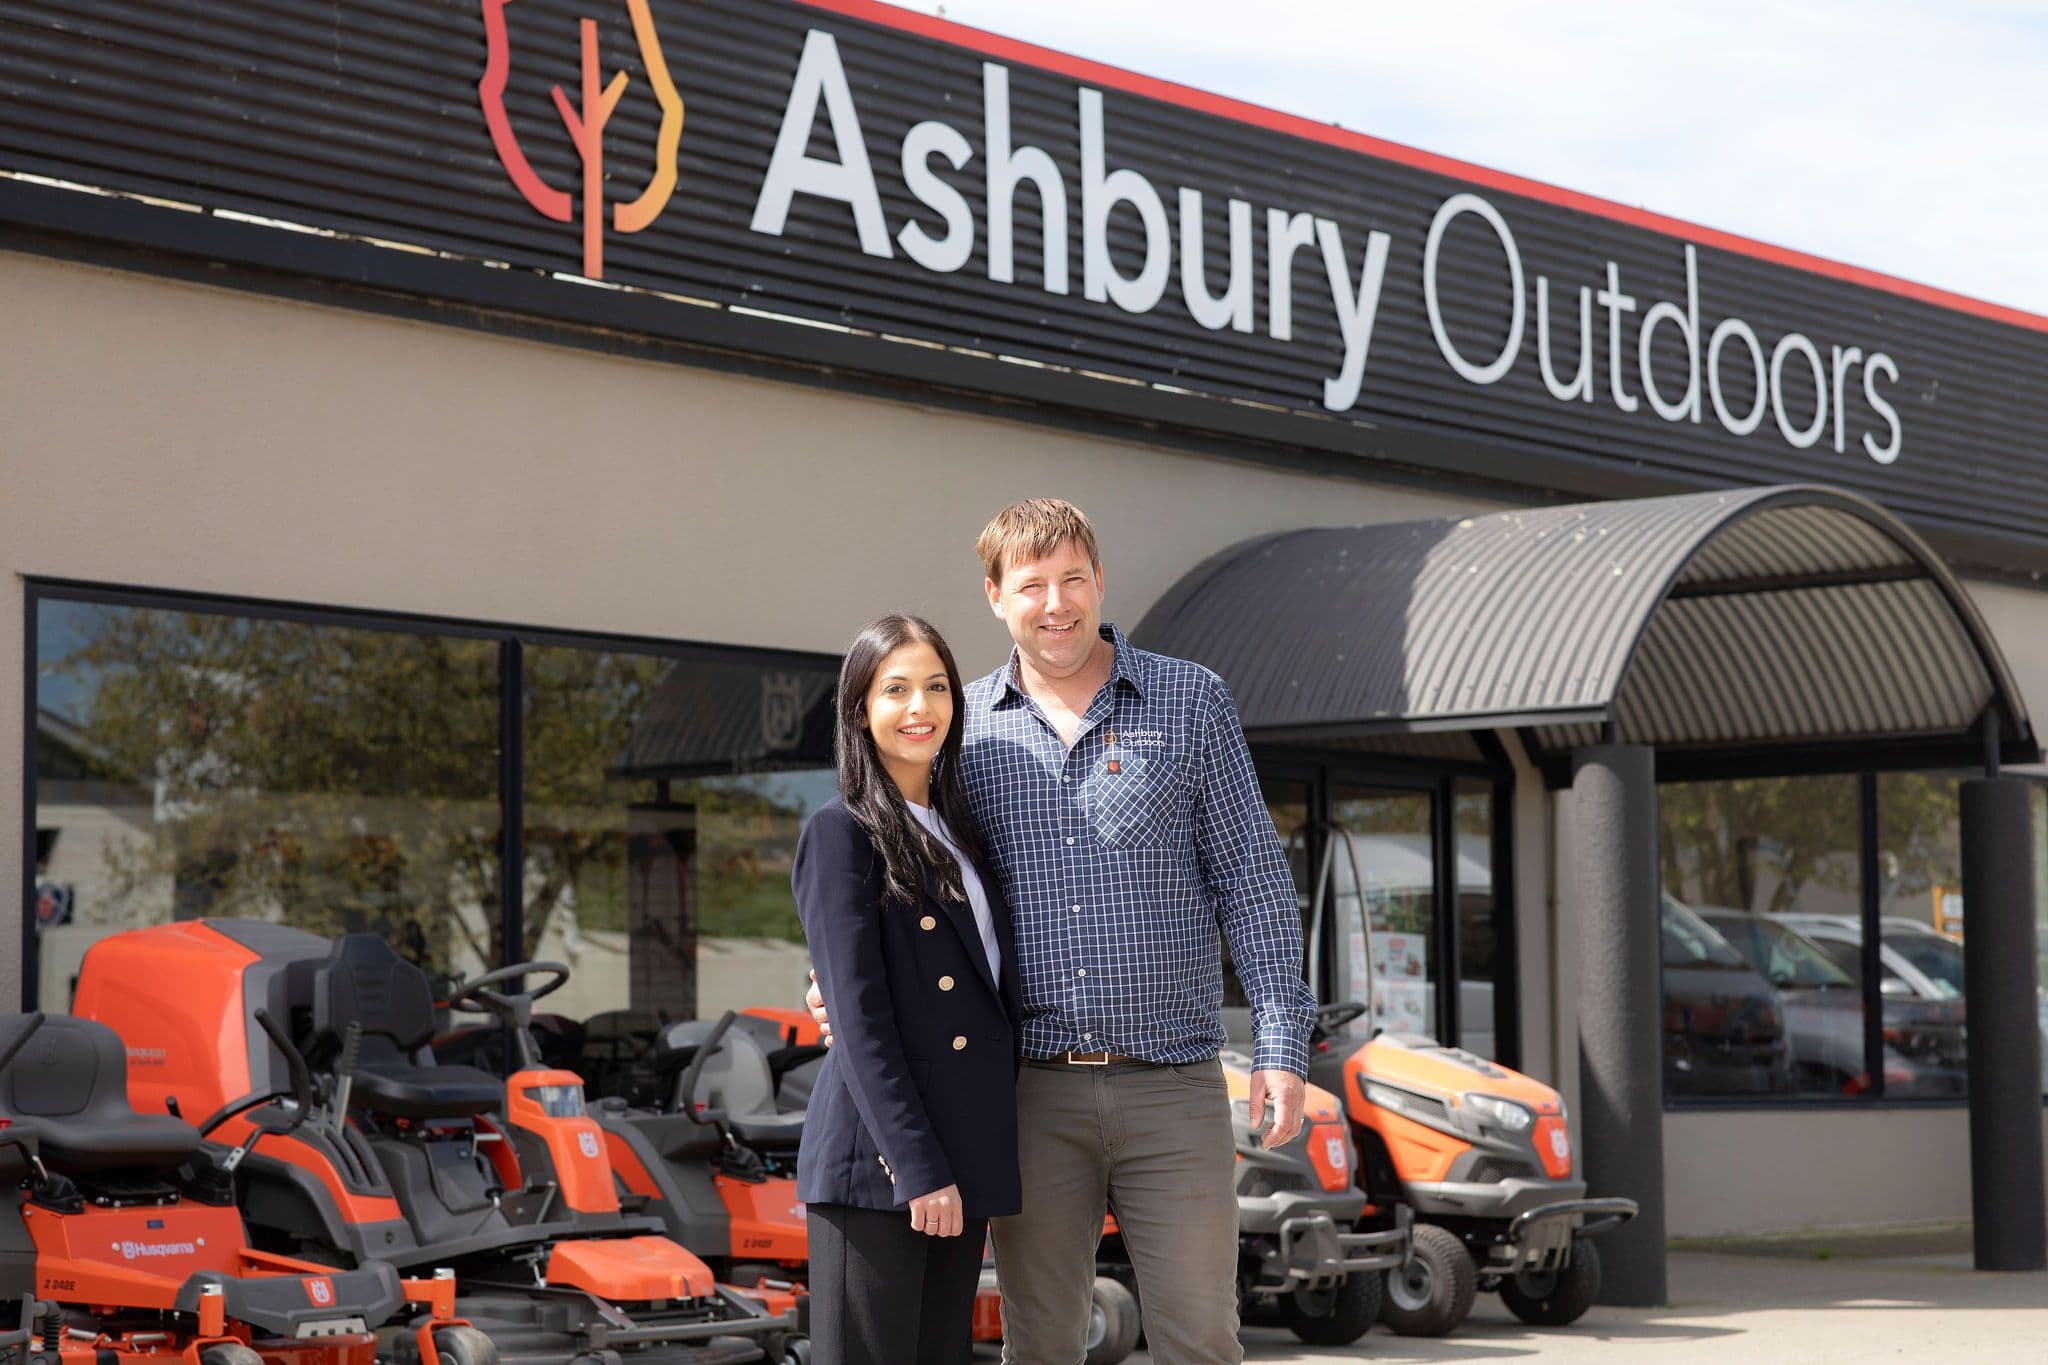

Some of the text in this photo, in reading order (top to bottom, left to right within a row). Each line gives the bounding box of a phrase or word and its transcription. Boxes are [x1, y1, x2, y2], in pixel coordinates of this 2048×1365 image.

[750, 29, 1902, 464] Ashbury Outdoors
[1122, 728, 1162, 739] Ashbury
[1122, 737, 1165, 747] Outdoors
[134, 1242, 195, 1257] Husqvarna
[44, 1280, 76, 1291] Z 242E
